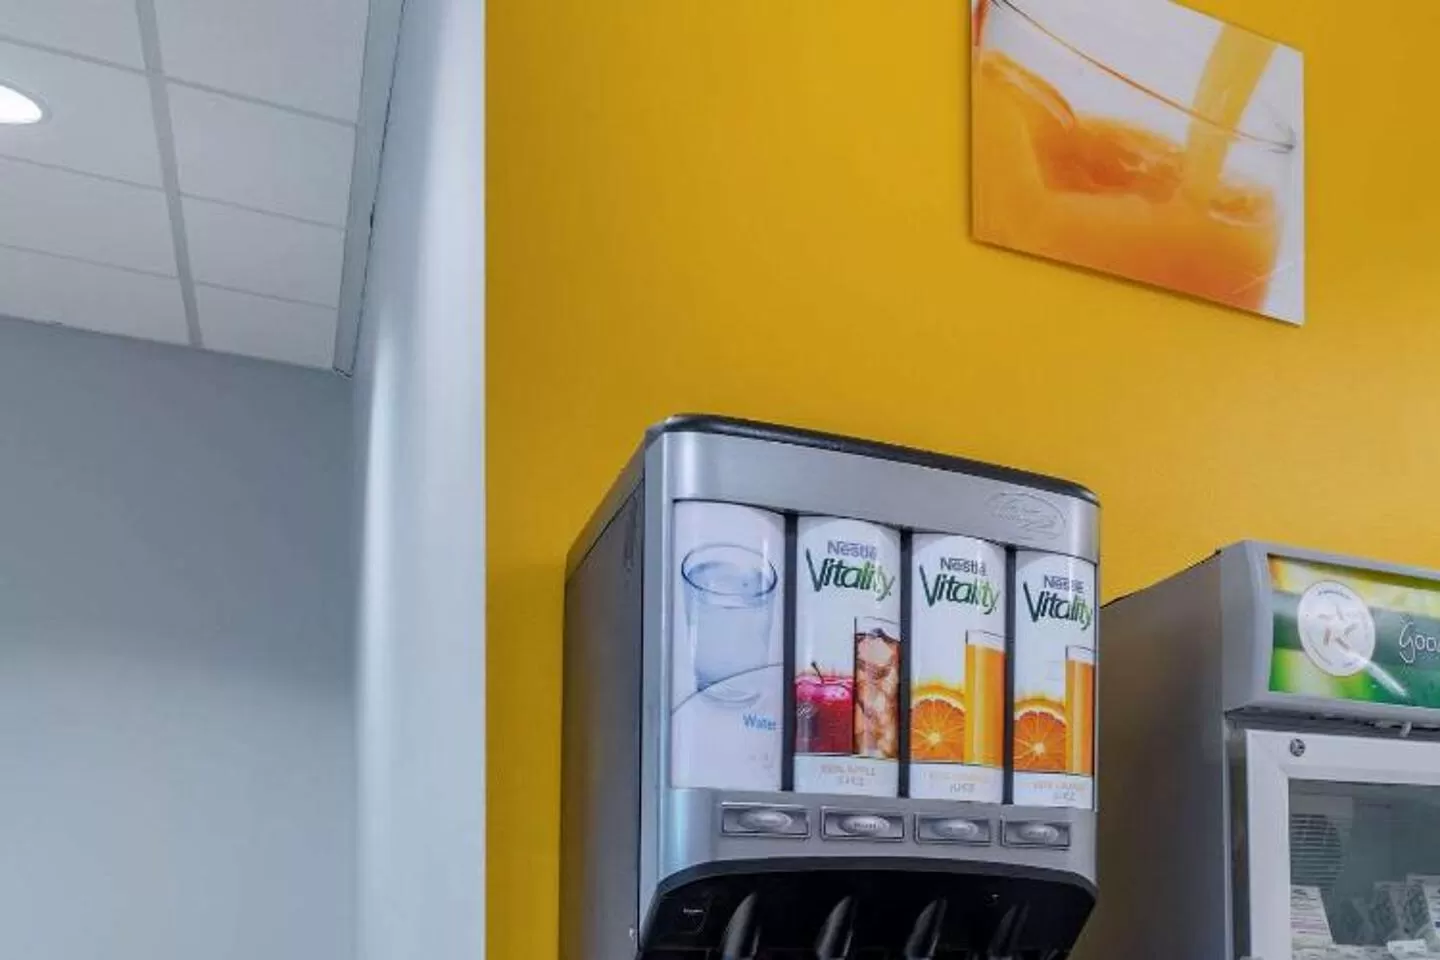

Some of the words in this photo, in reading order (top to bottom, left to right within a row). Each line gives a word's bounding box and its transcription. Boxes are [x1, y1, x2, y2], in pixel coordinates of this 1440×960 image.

[805, 547, 896, 602] Vitality
[919, 564, 1000, 615] Vitality
[1023, 581, 1093, 631] Vitality
[742, 712, 777, 731] Water
